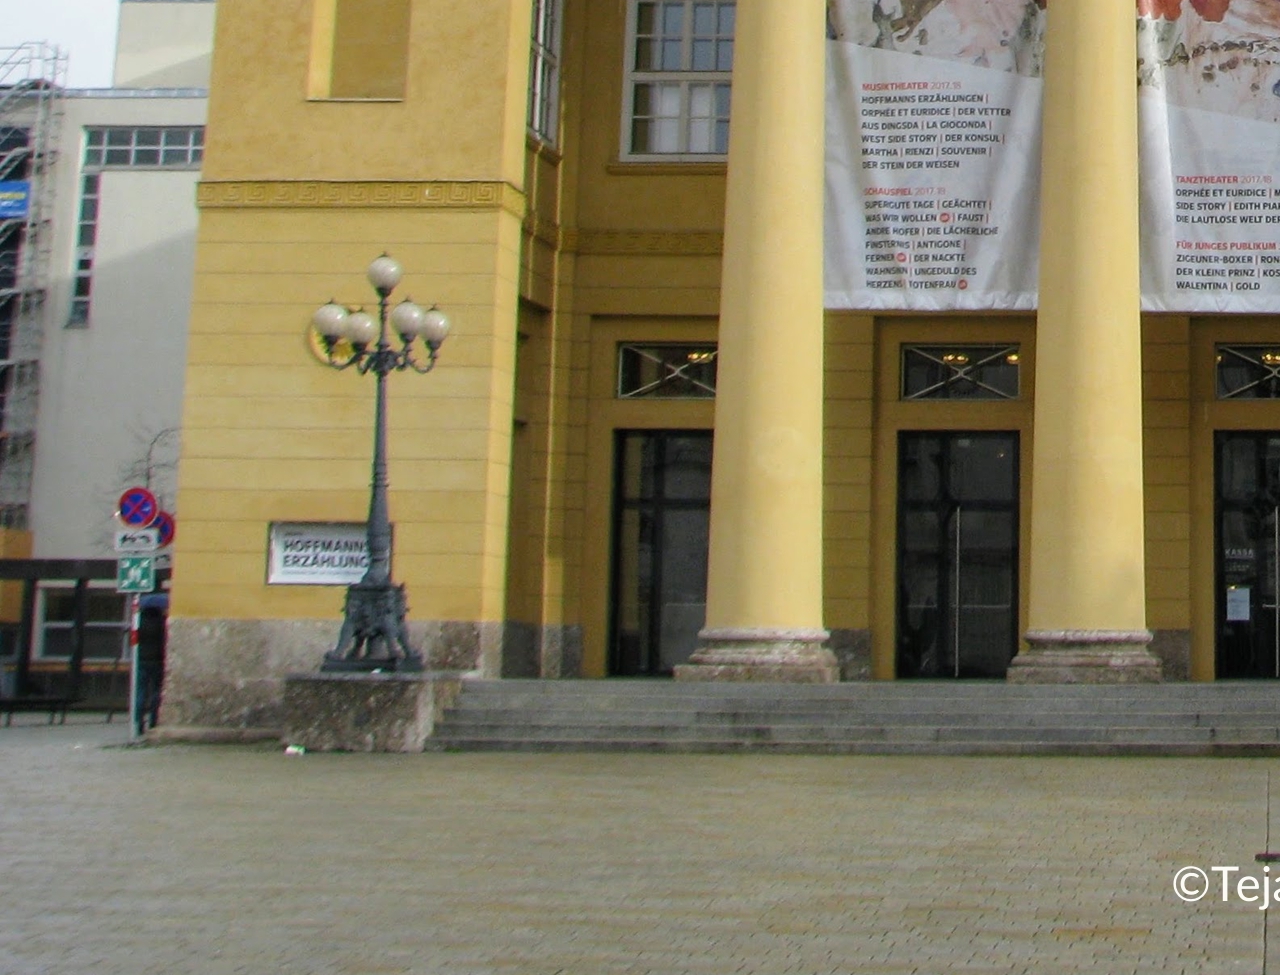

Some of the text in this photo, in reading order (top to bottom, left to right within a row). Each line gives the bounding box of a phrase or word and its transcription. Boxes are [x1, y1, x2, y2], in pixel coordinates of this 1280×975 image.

[862, 81, 929, 92] MUSIKTHEATER
[861, 92, 984, 104] HOFFMANNS ERZÄHLUNGEN
[861, 107, 1012, 118] ORPHÉE ET EURIDICE DER VETTER
[861, 120, 987, 131] AUS DINGSDA LA GIOCONDA
[861, 133, 1001, 144] WEST SIDE STORY DER KONSUL
[861, 147, 987, 157] MARTHA RIENZI SOUVENIR
[862, 160, 960, 170] DER STEIN DER WEISEN
[1176, 175, 1239, 184] TANZTHEATER
[1175, 186, 1211, 198] ORPHÉE
[1212, 188, 1224, 197] ET
[1226, 188, 1267, 198] EURIDICE
[913, 200, 935, 209] TAGE
[942, 198, 987, 209] GEÄCHTET
[1175, 201, 1195, 211] SIDE
[1196, 202, 1226, 211] STORY
[1234, 202, 1261, 211] EDITH
[865, 214, 881, 223] WAS
[882, 213, 900, 222] WIR
[901, 214, 938, 223] WOLLEN
[957, 213, 985, 222] FAUST
[1175, 214, 1189, 223] DIE
[1191, 215, 1238, 224] LAUTLOSE
[1239, 215, 1264, 224] WELT
[892, 227, 920, 236] HOFER
[927, 226, 942, 235] DIE
[943, 224, 999, 236] LÄCHERLICHE
[916, 240, 962, 249] ANTIGONE
[1176, 239, 1193, 250] FÜR
[1194, 241, 1228, 251] JUNGES
[1229, 241, 1277, 251] PUBLIKUM
[913, 253, 930, 263] DER
[931, 253, 966, 262] NACKTE
[1176, 254, 1253, 264] ZIGEUNER-BOXER
[866, 266, 977, 276] WAHNSINN UNGEDULD DES
[1176, 267, 1194, 276] DER
[1195, 268, 1227, 277] KLEINE
[1228, 268, 1255, 278] PRINZ
[908, 280, 957, 290] TOTENFRAU
[1176, 281, 1261, 291] WALENTINA GOLD
